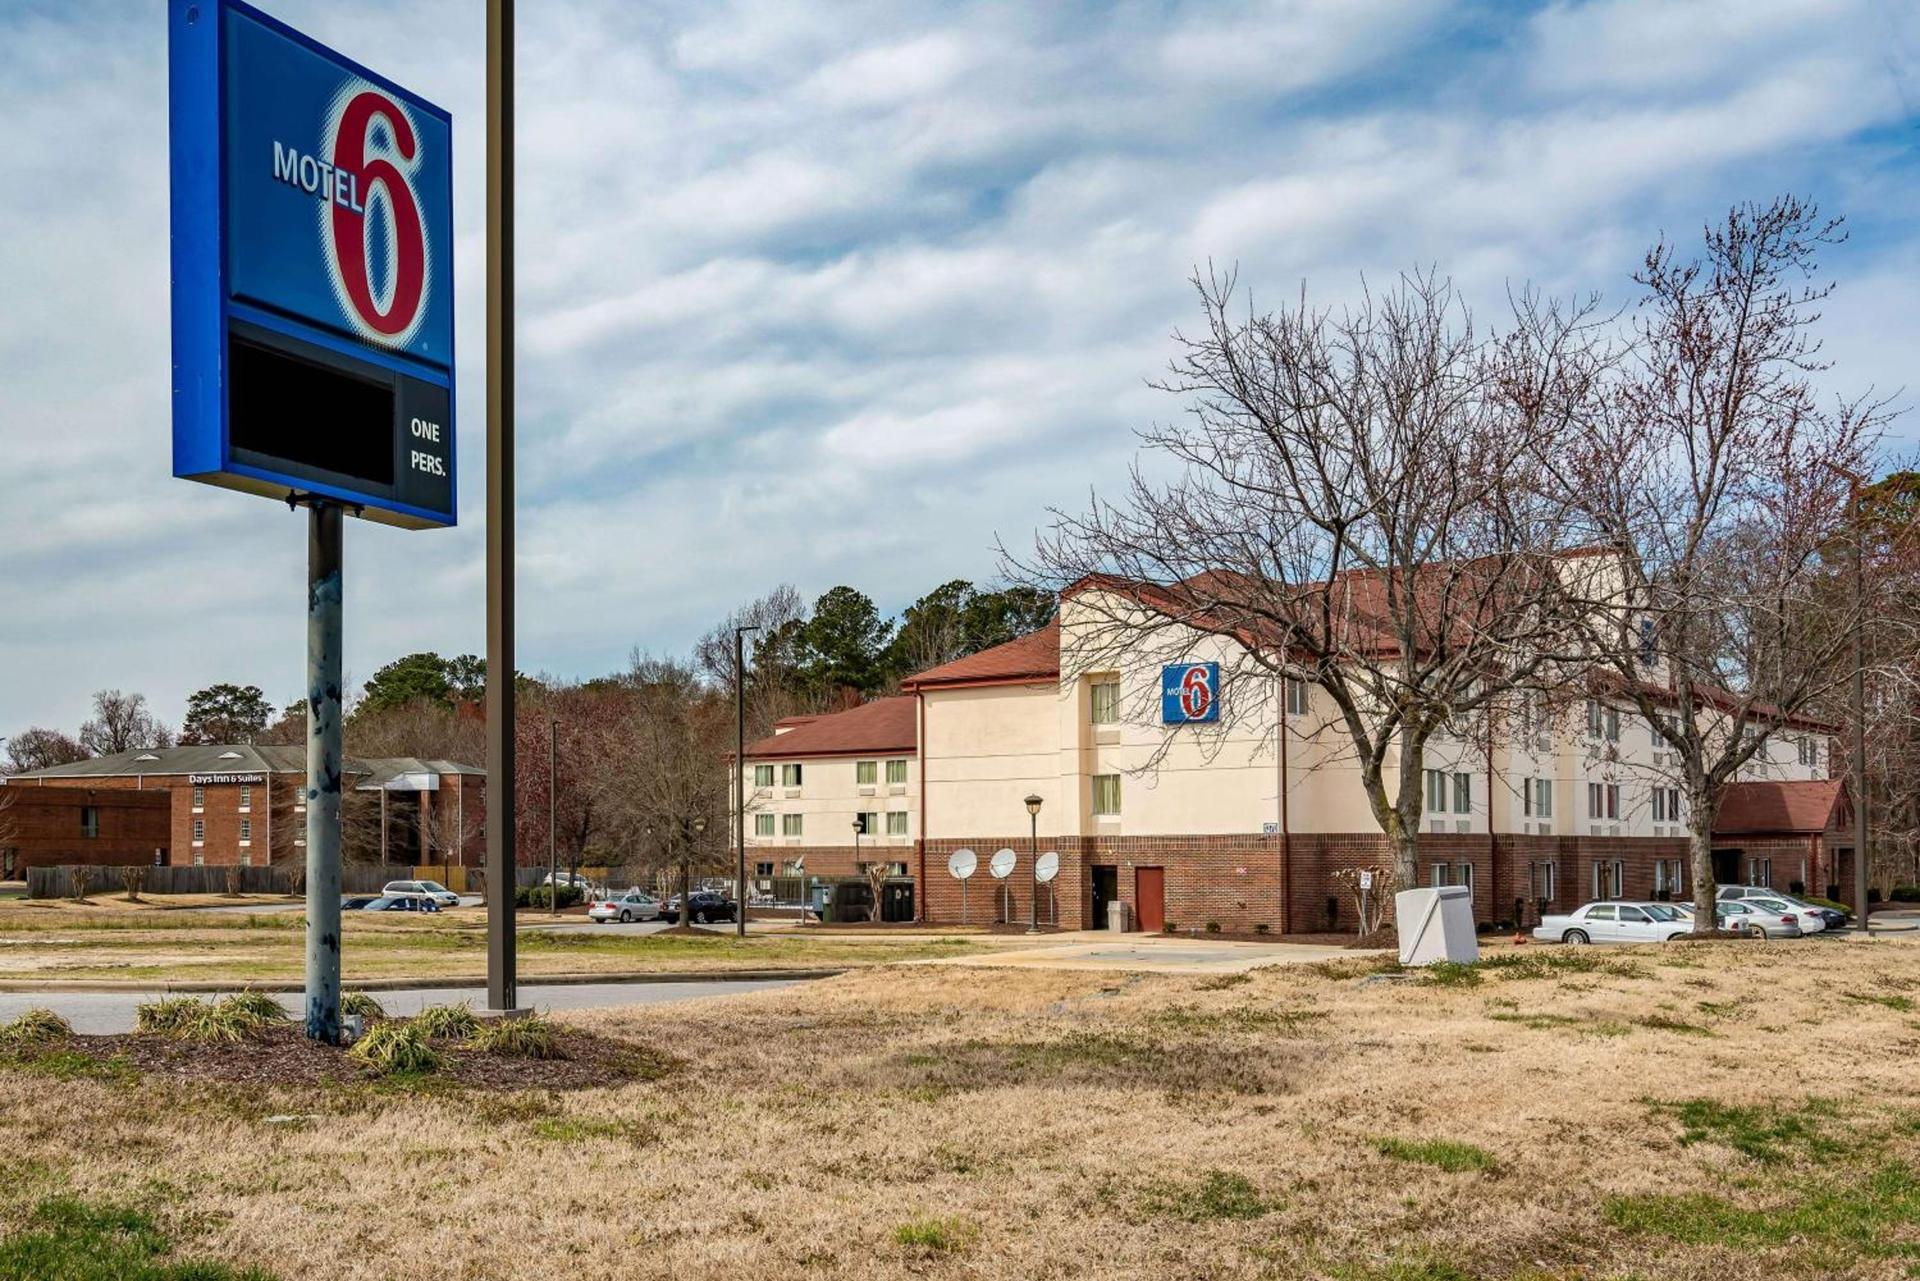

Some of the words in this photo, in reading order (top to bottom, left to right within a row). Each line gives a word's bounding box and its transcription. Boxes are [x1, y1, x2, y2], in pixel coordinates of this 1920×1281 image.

[273, 140, 363, 213] MOTEL
[332, 90, 426, 337] 6
[411, 417, 440, 443] ONE
[411, 449, 446, 477] PERS.
[1181, 666, 1210, 719] 6
[189, 774, 213, 785] Days
[213, 774, 230, 783] Inn
[230, 774, 237, 783] &
[237, 773, 262, 783] Suites
